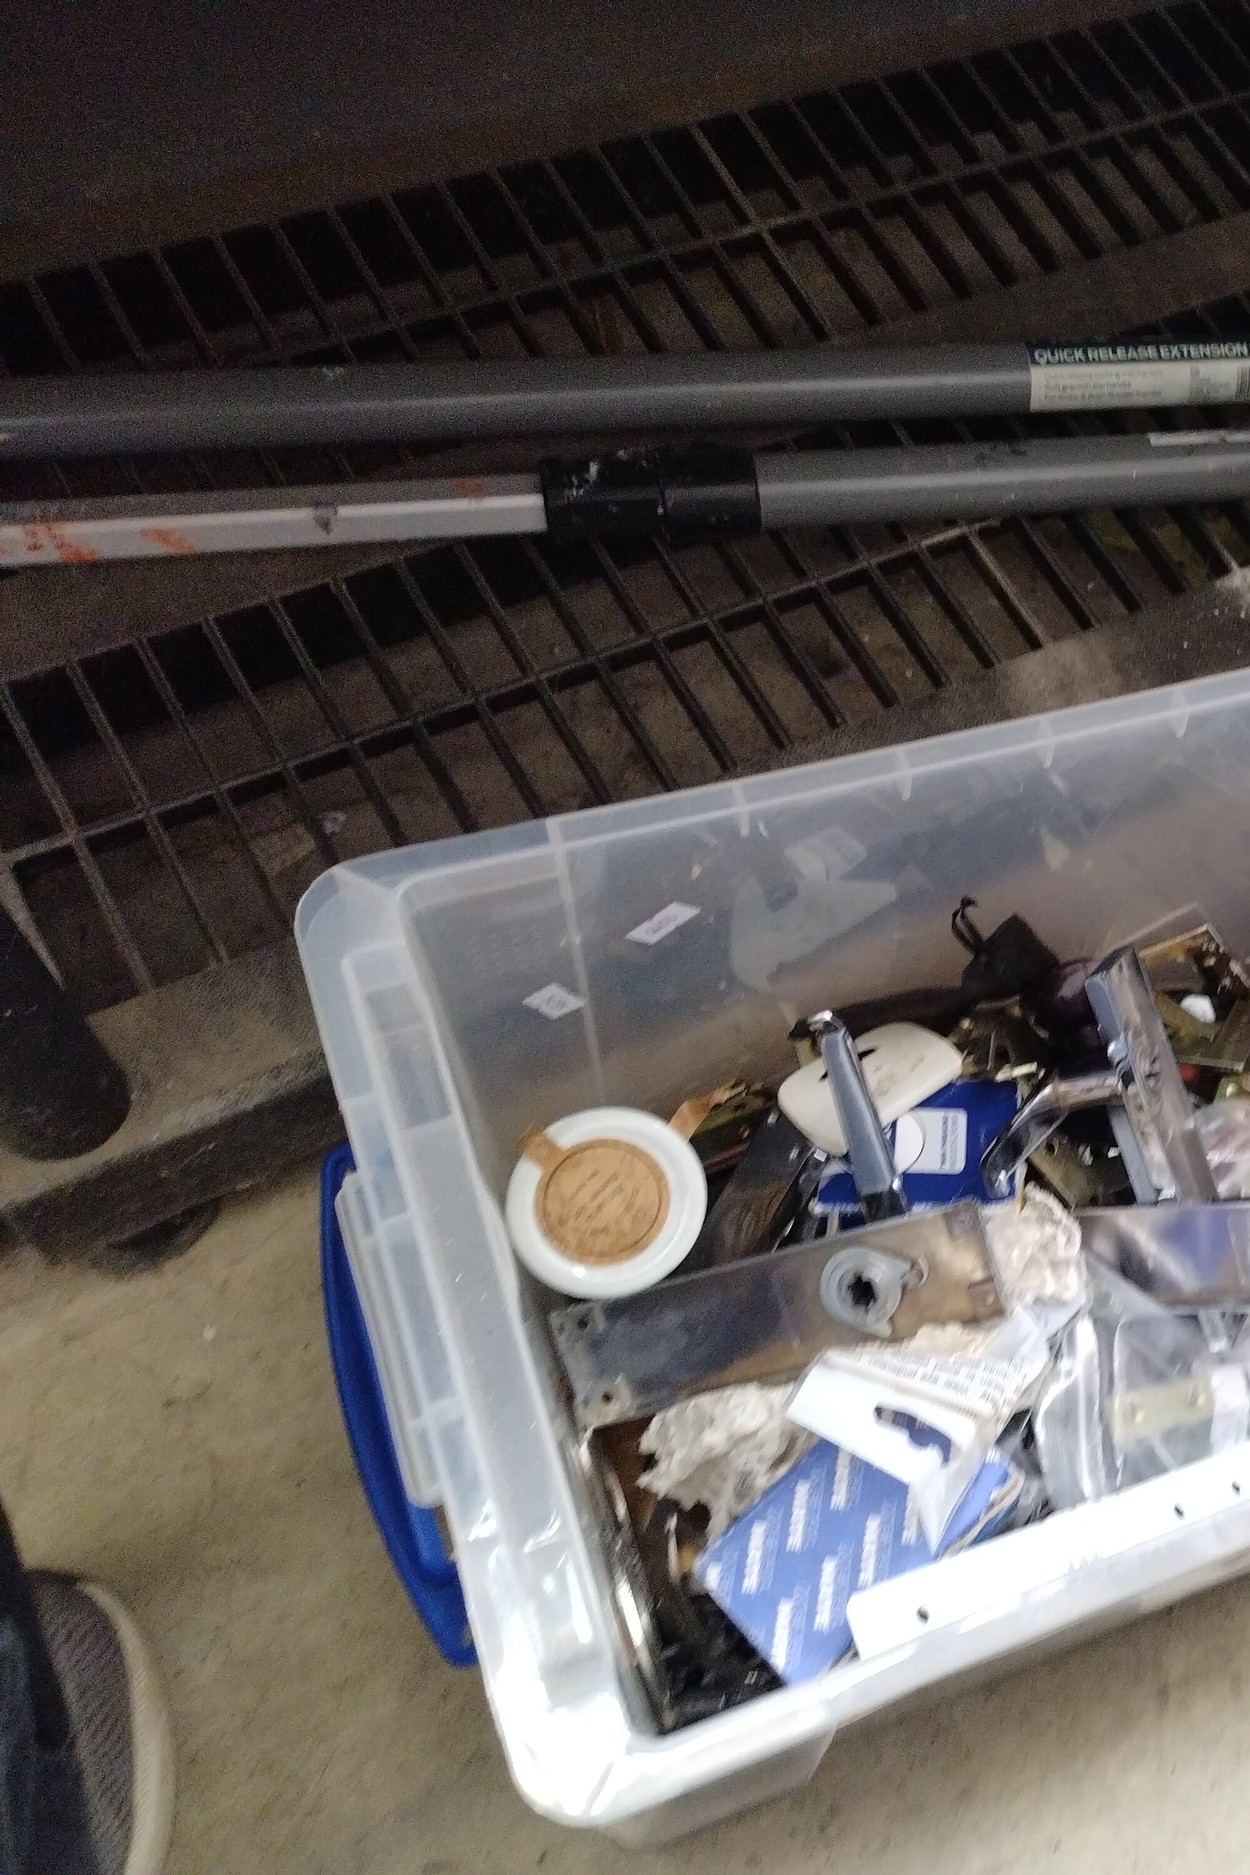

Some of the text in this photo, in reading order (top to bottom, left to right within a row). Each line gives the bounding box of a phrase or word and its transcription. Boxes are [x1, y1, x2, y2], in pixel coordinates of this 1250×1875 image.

[1034, 346, 1085, 366] QUICK
[1086, 344, 1159, 362] RELEASE
[1159, 341, 1248, 361] EXTENSION
